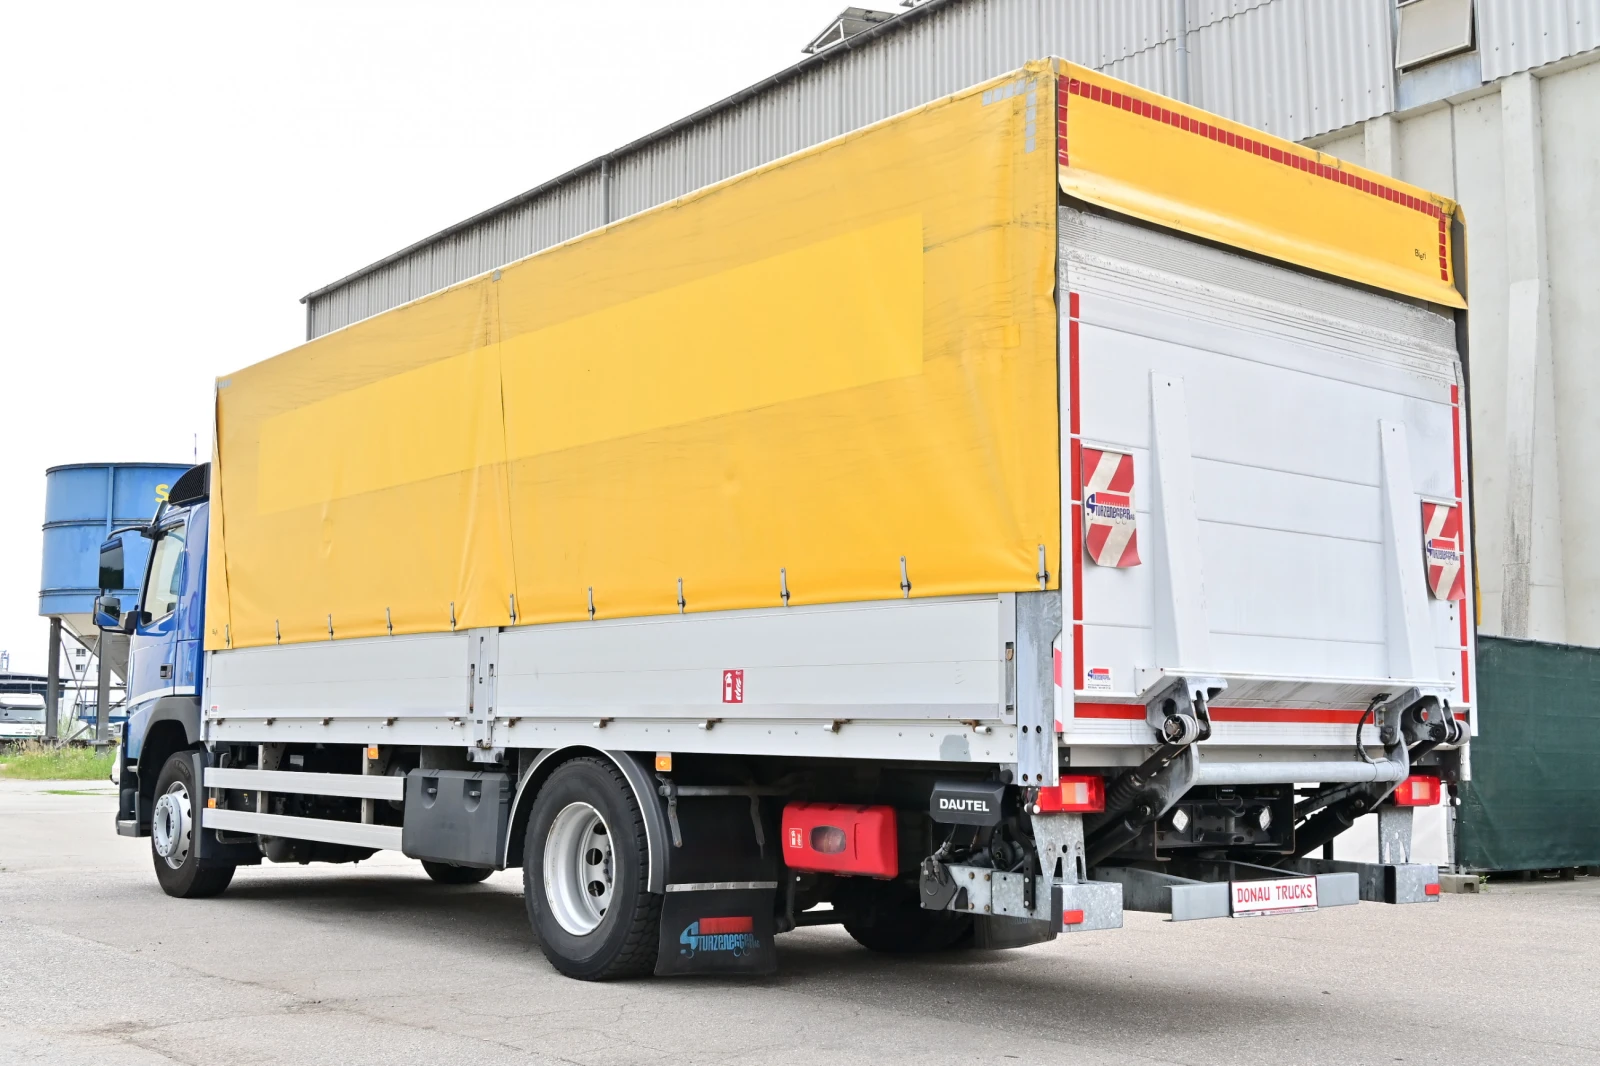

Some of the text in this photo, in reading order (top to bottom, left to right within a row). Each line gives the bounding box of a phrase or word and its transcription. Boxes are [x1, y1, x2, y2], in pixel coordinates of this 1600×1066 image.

[939, 798, 990, 812] DAUTEL
[1237, 884, 1313, 903] DONAU TRUCKS
